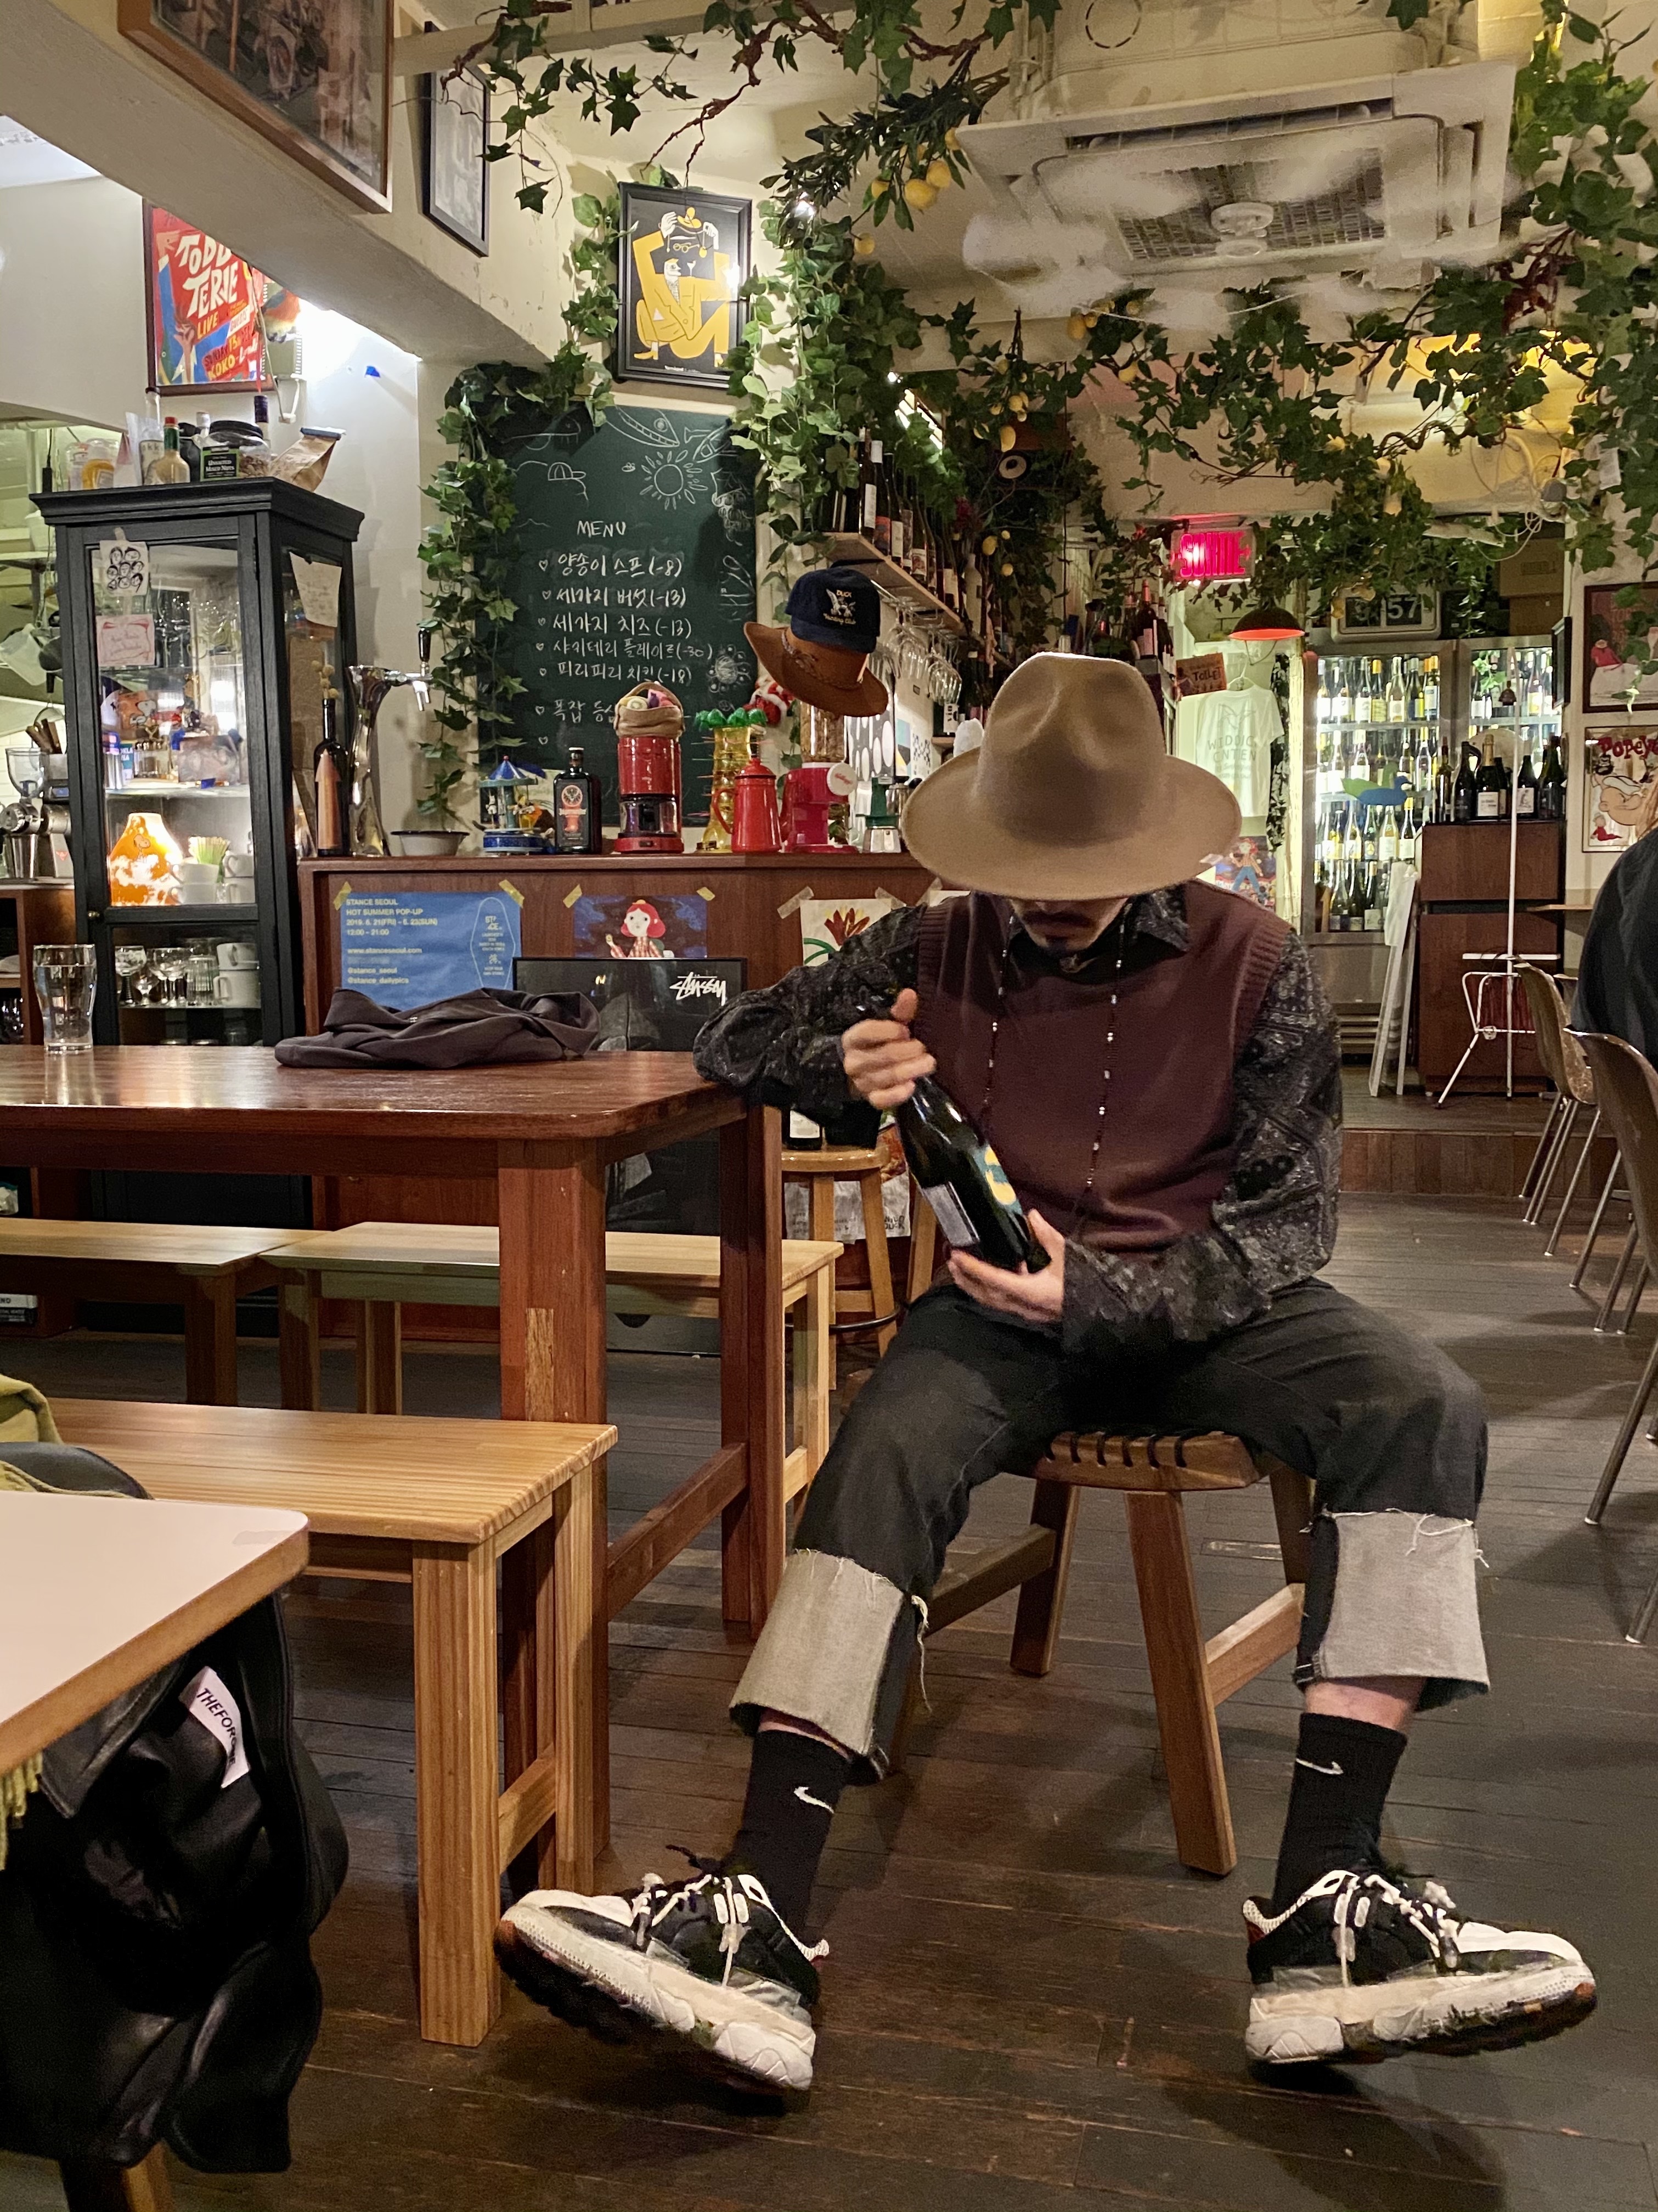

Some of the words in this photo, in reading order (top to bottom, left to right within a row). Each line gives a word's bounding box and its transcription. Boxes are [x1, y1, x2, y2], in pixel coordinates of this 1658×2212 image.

[174, 234, 232, 274] TODD
[198, 311, 218, 339] LIVE
[208, 354, 236, 379] KOKO
[577, 521, 625, 538] MENU
[558, 553, 606, 577] 양송이
[556, 586, 608, 607] 세가지
[1387, 597, 1422, 619] 57
[553, 612, 607, 635] 세가지
[557, 661, 622, 680] 피리피리
